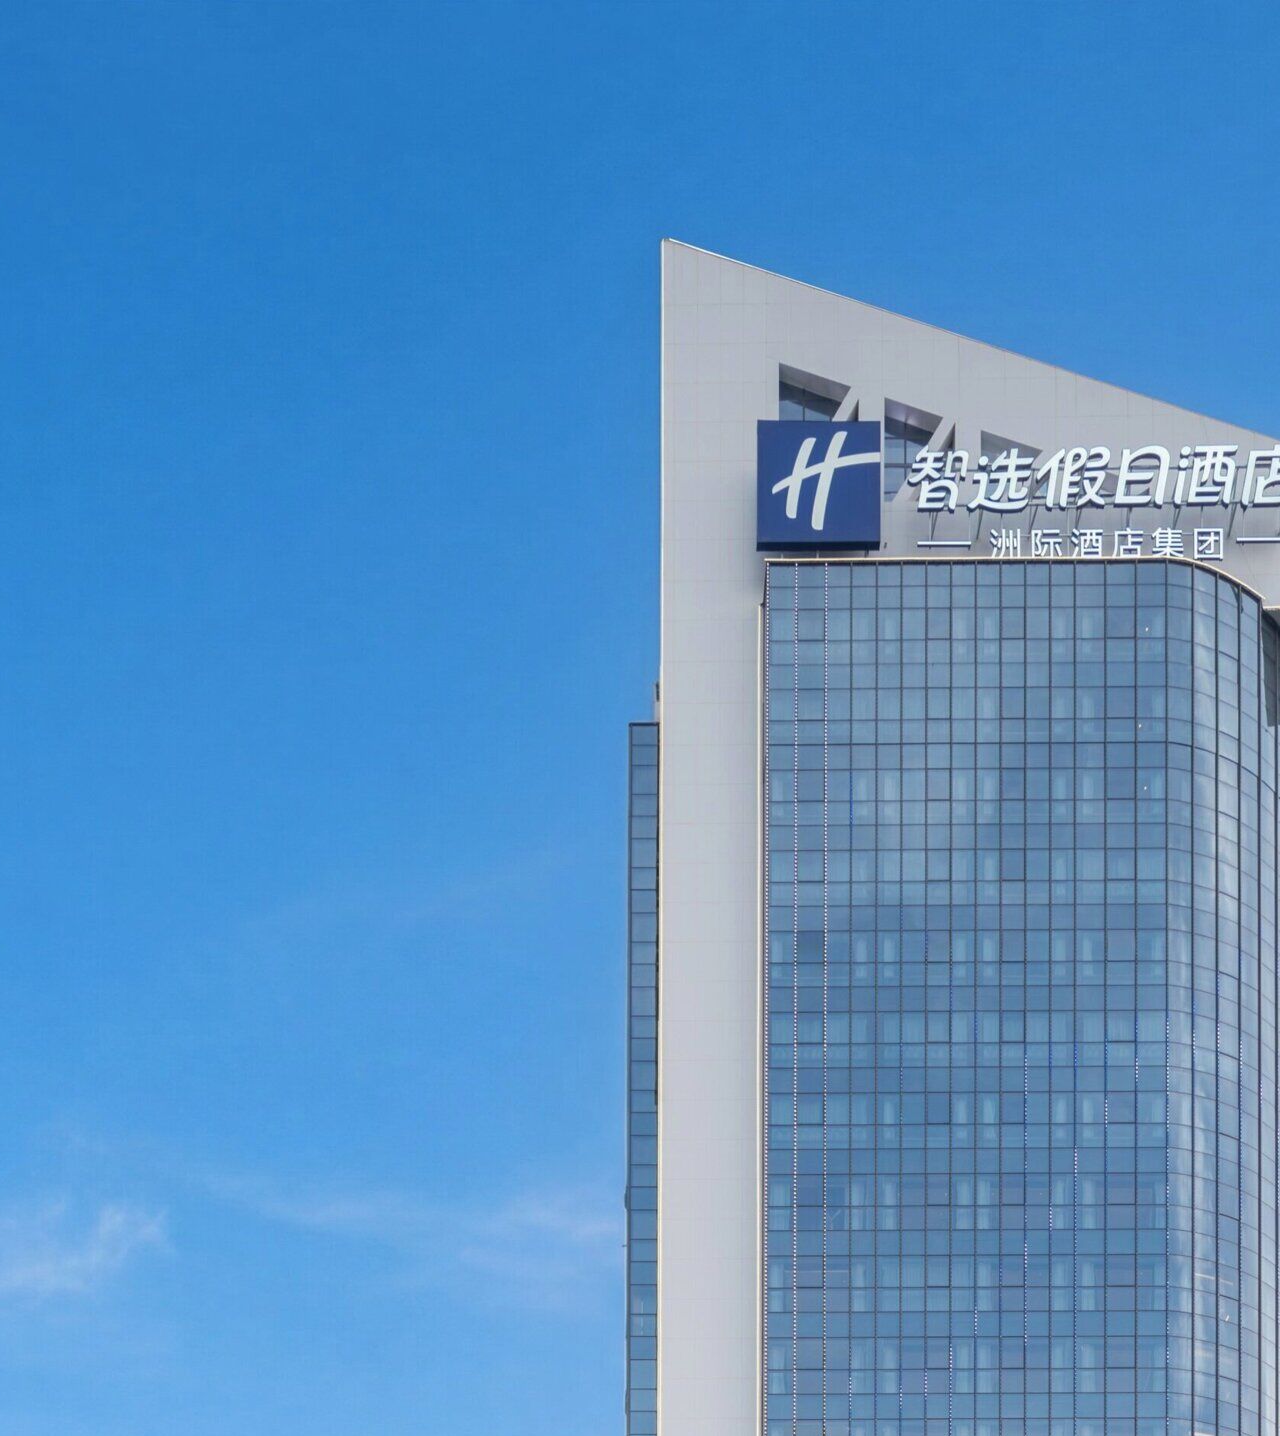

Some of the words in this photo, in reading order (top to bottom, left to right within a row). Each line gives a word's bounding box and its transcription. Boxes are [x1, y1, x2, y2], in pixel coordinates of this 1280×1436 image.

[990, 528, 1224, 560] 洲际酒店集团
